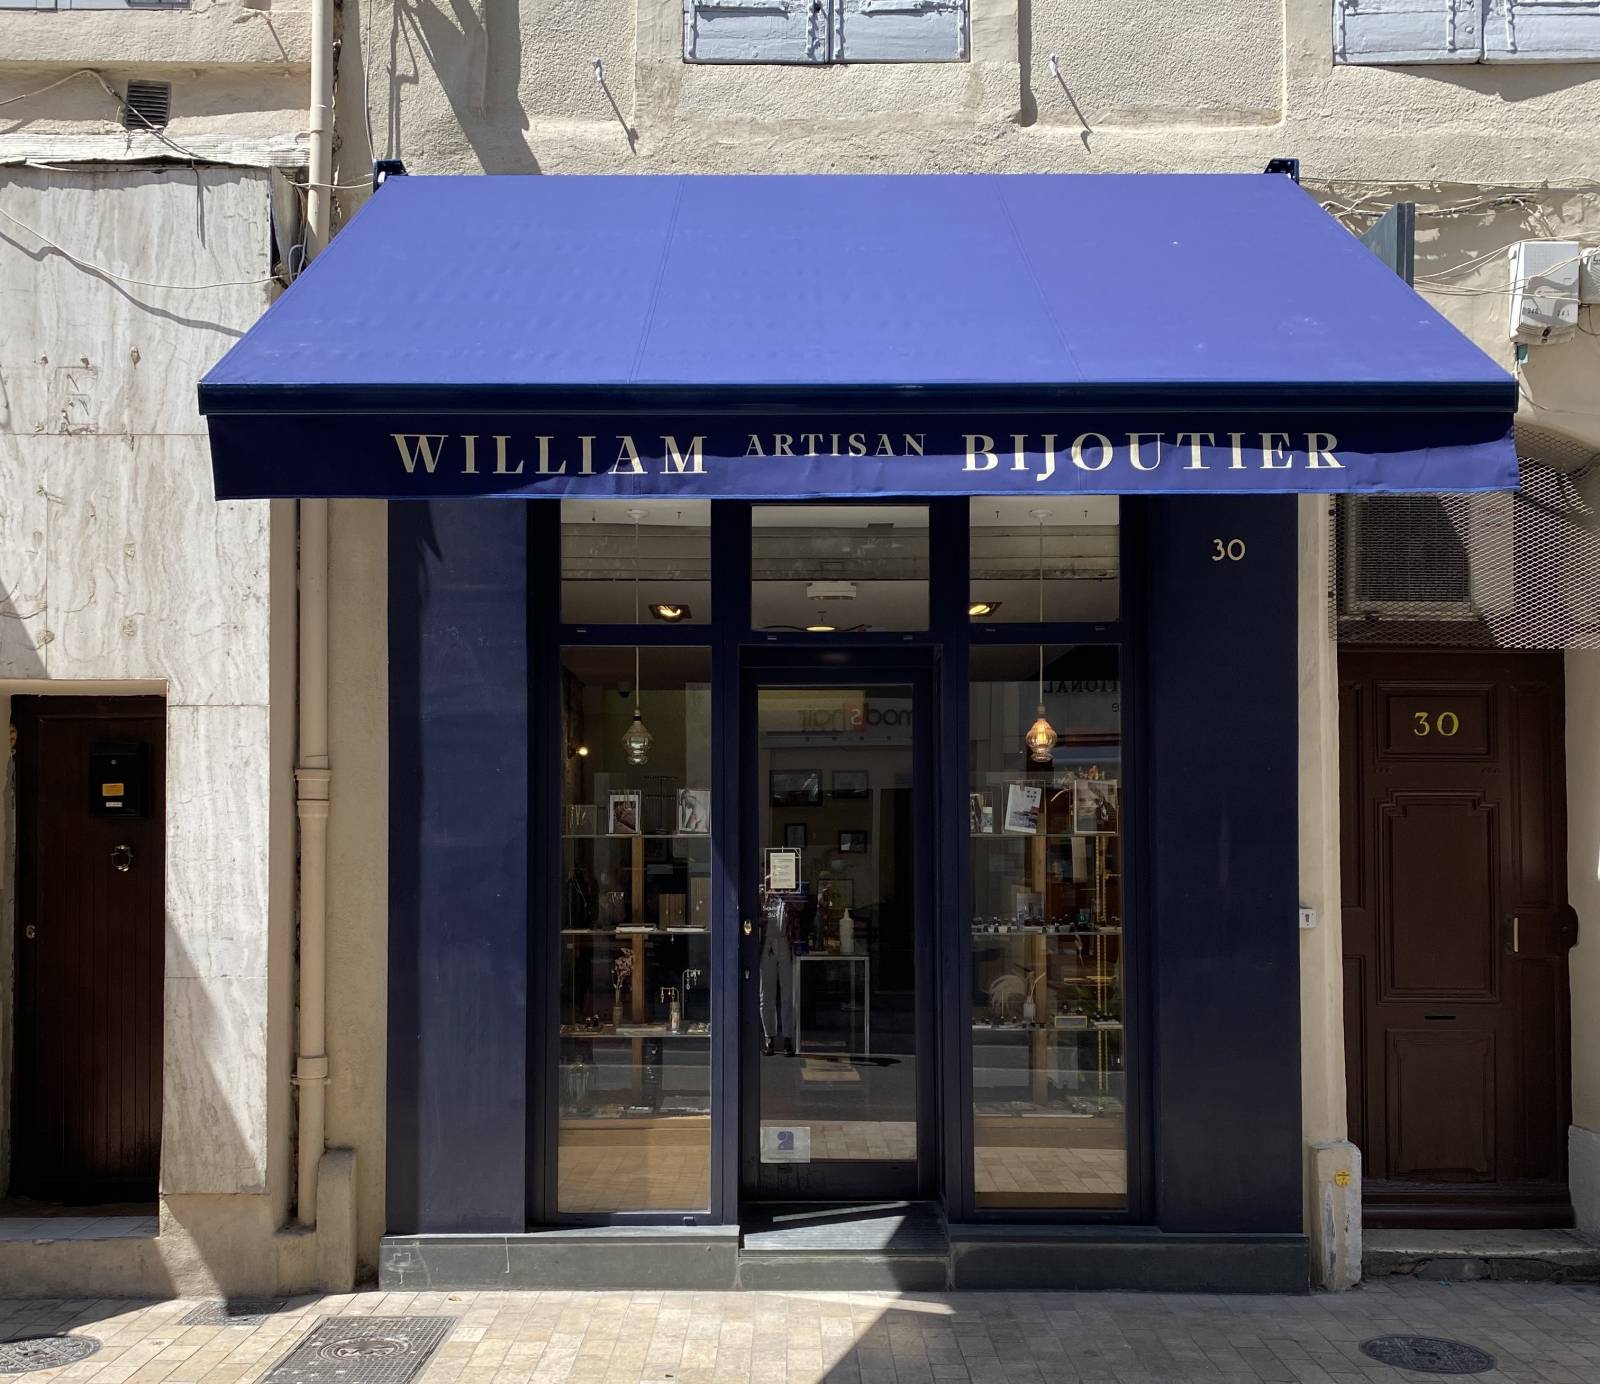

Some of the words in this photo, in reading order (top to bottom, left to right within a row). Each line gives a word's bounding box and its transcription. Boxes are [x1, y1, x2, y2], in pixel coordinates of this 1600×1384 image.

[389, 433, 708, 475] WILLIAM
[745, 433, 927, 457] ARTISAN
[961, 432, 1346, 482] BIJOUTIER
[1211, 538, 1246, 561] 30
[1413, 711, 1460, 736] 30
